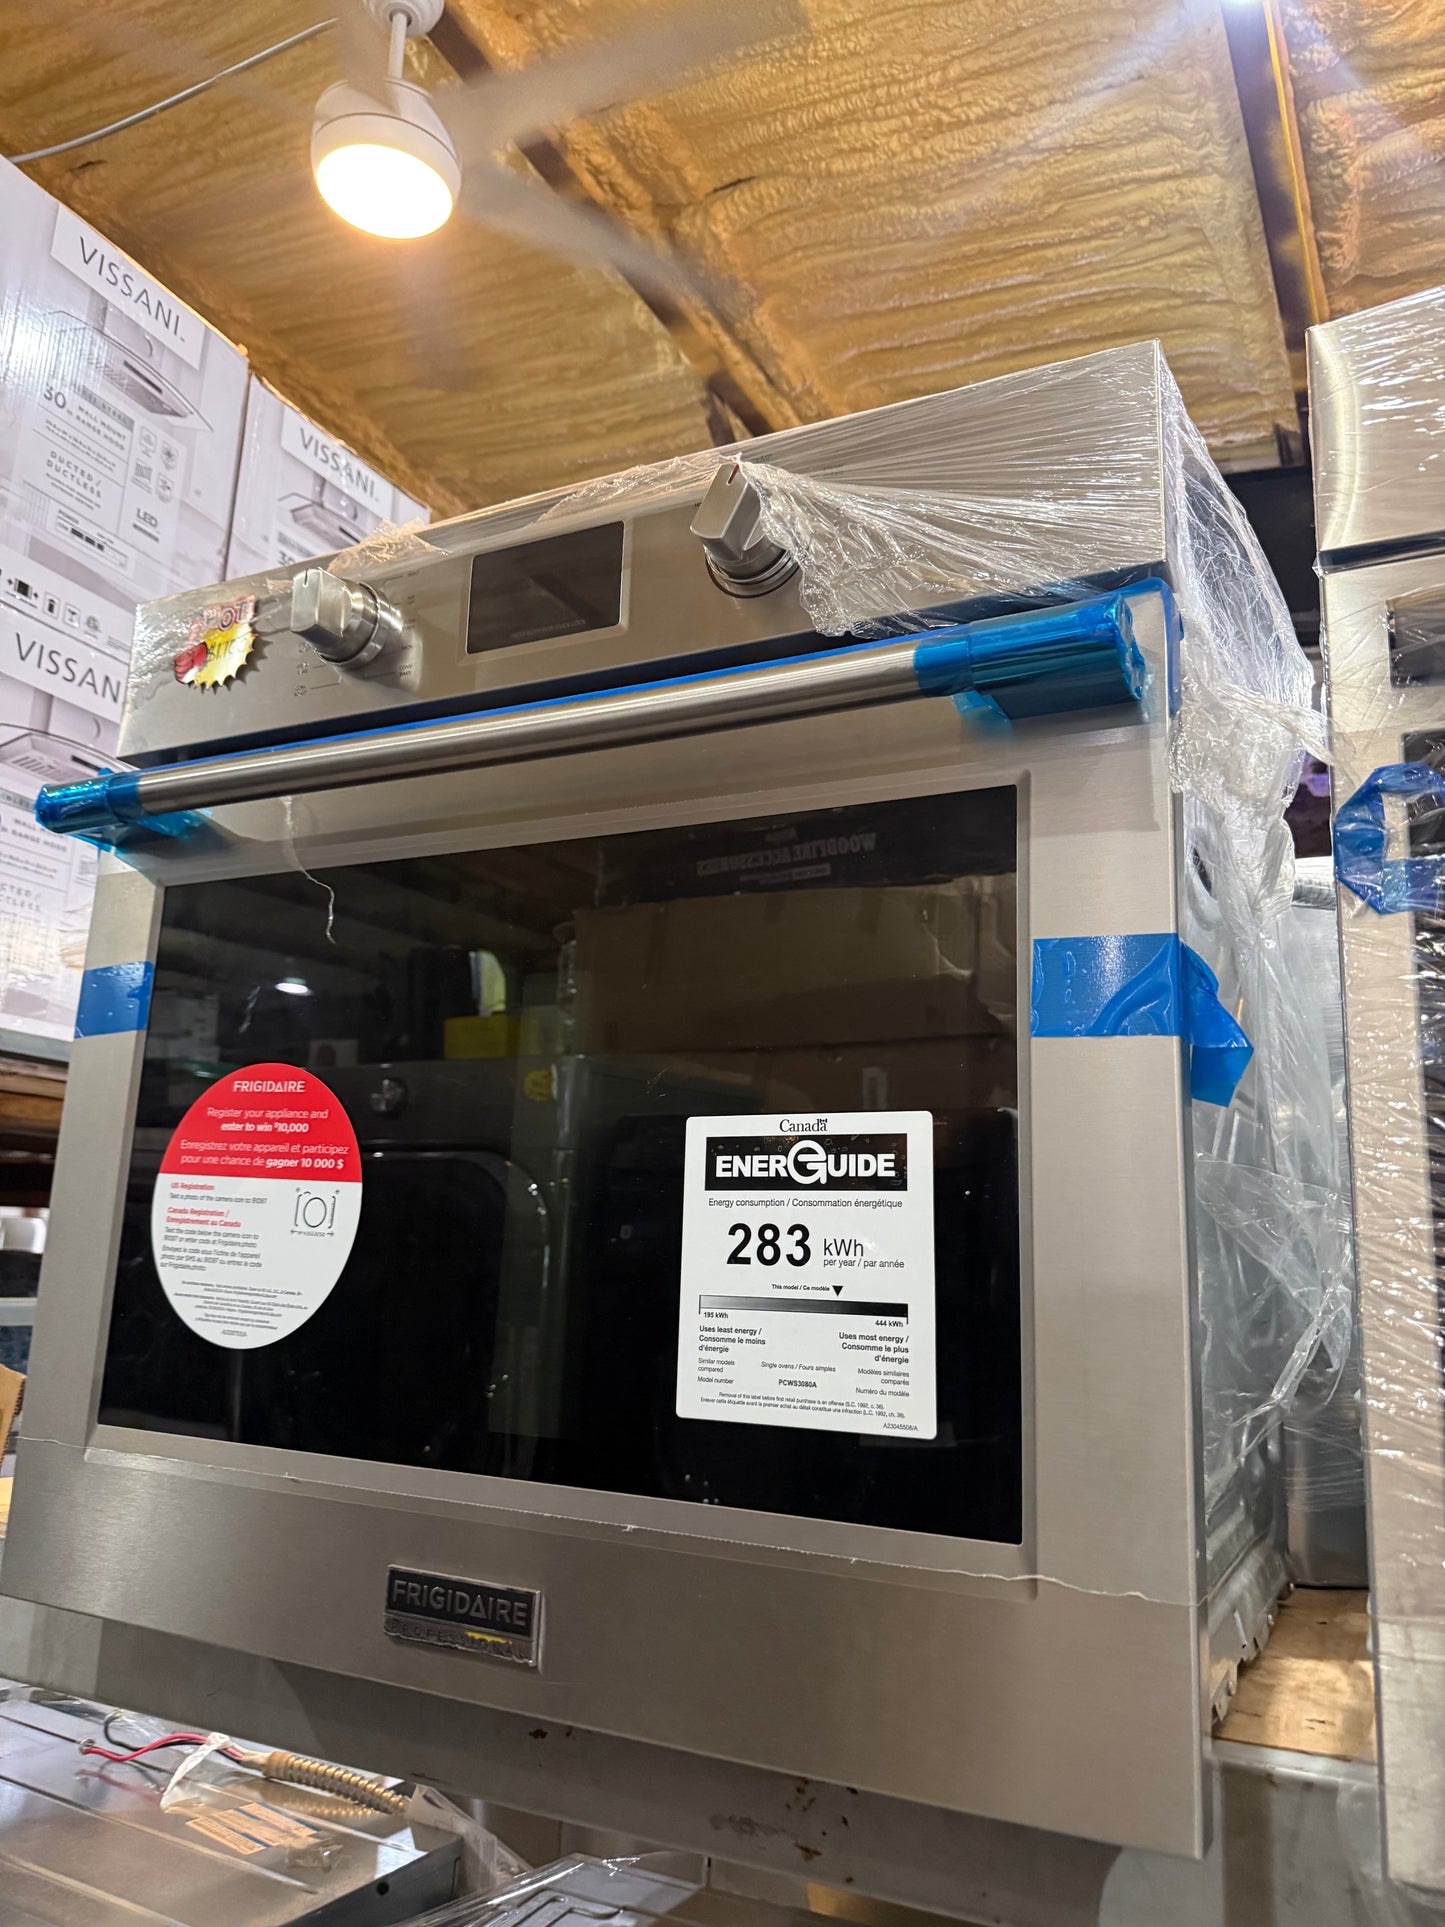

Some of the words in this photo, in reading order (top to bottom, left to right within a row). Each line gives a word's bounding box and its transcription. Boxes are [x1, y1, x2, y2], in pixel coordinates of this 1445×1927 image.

[80, 236, 180, 336] VISSANI
[50, 450, 94, 482] DUCTED
[300, 427, 375, 498] VISSANI
[46, 459, 102, 499] DUCTLESS
[136, 507, 159, 529] LED
[233, 1081, 306, 1093] FRIGIDAIRE
[208, 1108, 242, 1118] Register
[244, 1110, 263, 1119] your
[265, 1109, 308, 1119] appliance
[310, 1109, 328, 1118] and
[221, 1123, 242, 1131] enter
[245, 1123, 255, 1131] to
[257, 1123, 272, 1132] win
[274, 1123, 309, 1133] $10,000
[779, 1119, 828, 1132] Canada
[181, 1140, 227, 1151] Enregistrez
[229, 1143, 251, 1151] votre
[253, 1143, 289, 1153] appareil
[291, 1145, 300, 1153] et
[302, 1145, 349, 1155] participez
[181, 1156, 201, 1164] pour
[221, 1155, 251, 1166] chance
[252, 1157, 265, 1166] de
[266, 1159, 298, 1168] gagner
[301, 1158, 312, 1167] 10
[314, 1158, 335, 1168] 000
[337, 1159, 344, 1169] $
[180, 1182, 215, 1191] Registration
[708, 1198, 733, 1209] Energy
[735, 1199, 785, 1208] consumption
[786, 1199, 791, 1207] /
[792, 1198, 852, 1207] Consommation
[854, 1198, 903, 1209] énergétique
[190, 1208, 225, 1217] Registration
[166, 1216, 209, 1225] Enregistrement
[218, 1219, 241, 1227] Canada
[726, 1223, 811, 1267] 283
[823, 1238, 864, 1257] kWh
[823, 1259, 837, 1268] per
[838, 1260, 855, 1268] year
[857, 1259, 862, 1268] /
[863, 1260, 877, 1269] par
[879, 1260, 904, 1268] année
[699, 1335, 736, 1343] Consomme
[745, 1337, 766, 1345] moins
[699, 1345, 729, 1353] d'énergie
[842, 1343, 883, 1351] Consomme
[761, 1361, 777, 1369] Single
[874, 1355, 909, 1364] d'énergie
[779, 1379, 817, 1388] PCWS3080A
[856, 1387, 878, 1395] Numéro
[392, 1579, 529, 1627] FRIGIDAIRE
